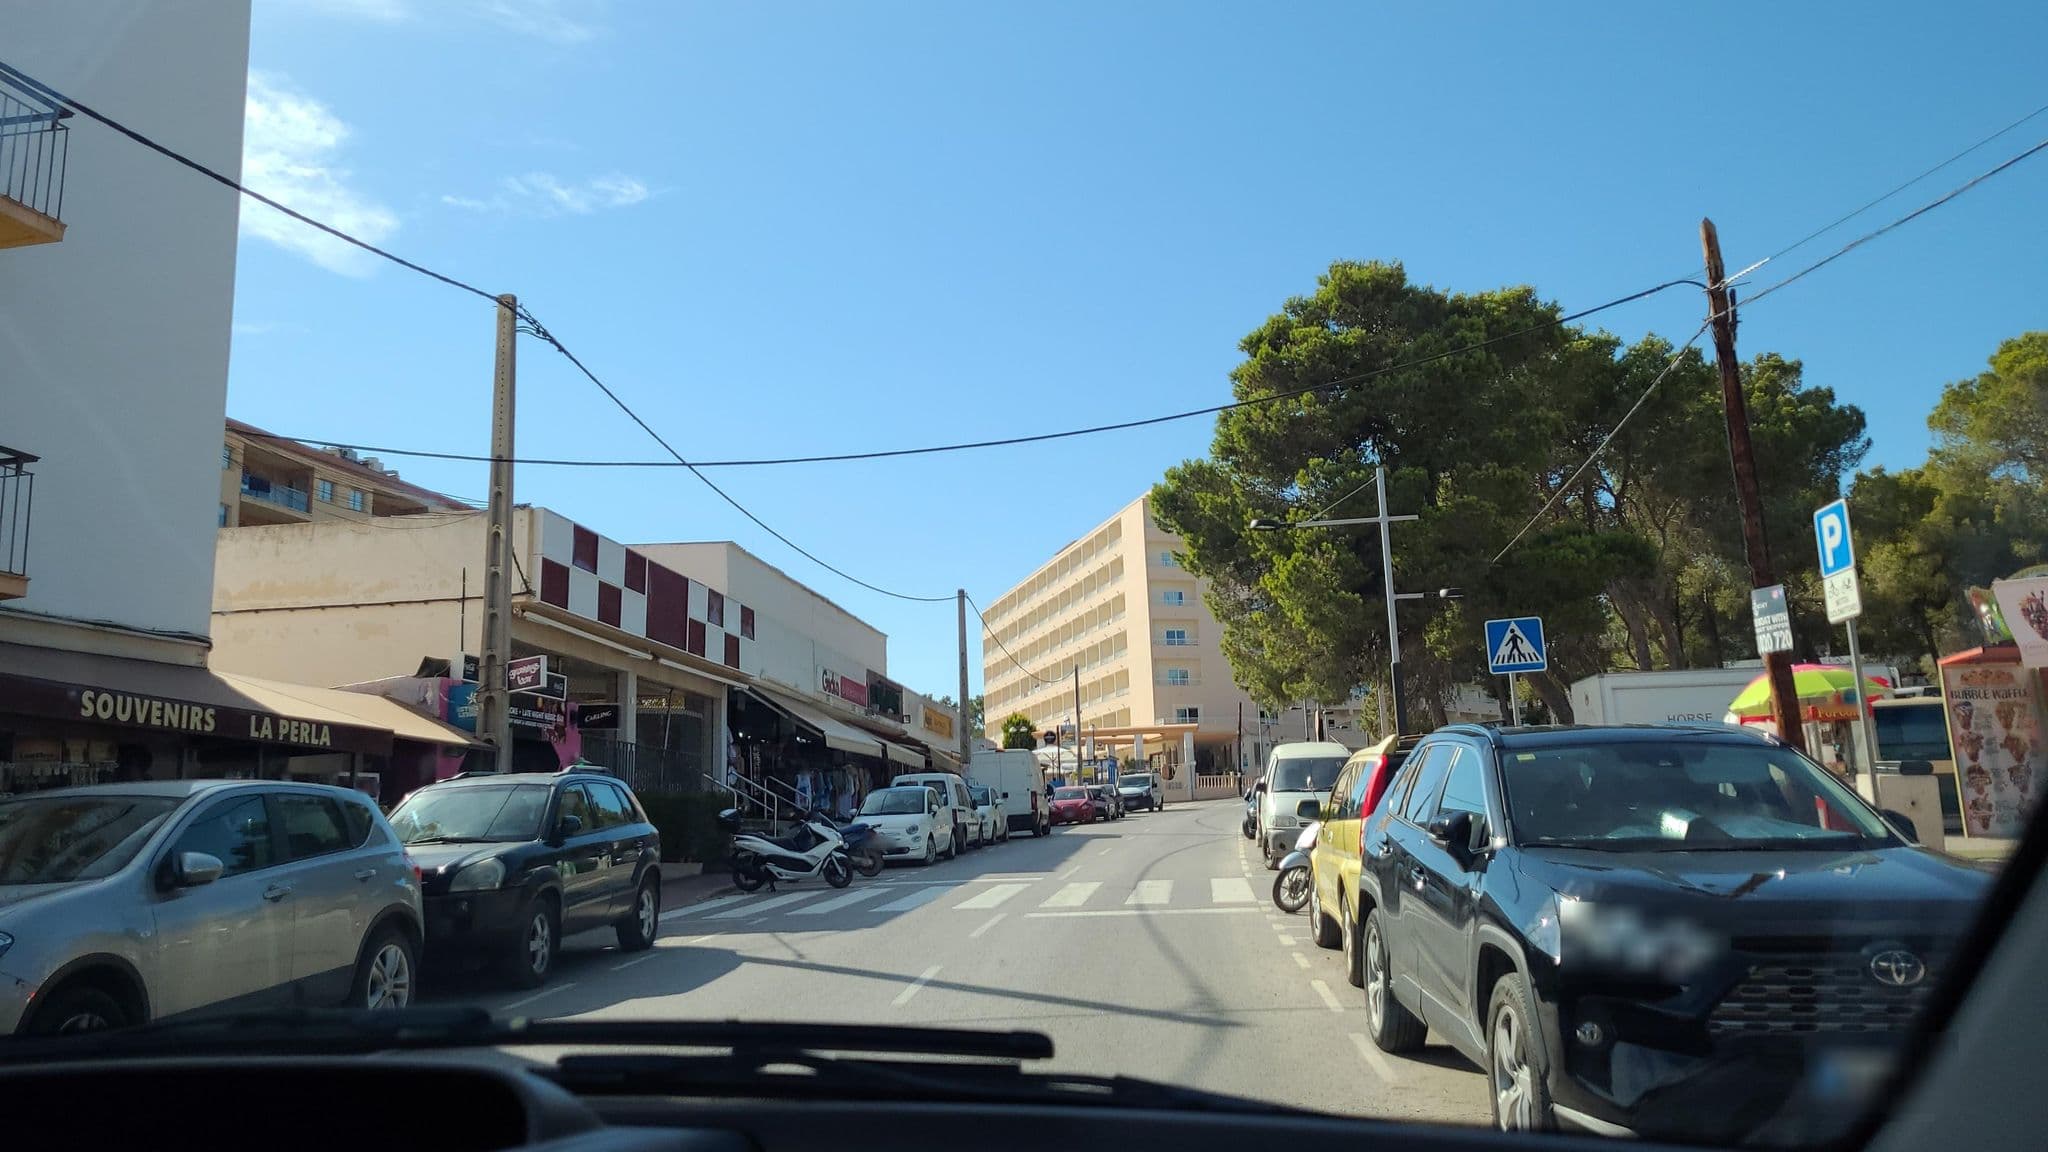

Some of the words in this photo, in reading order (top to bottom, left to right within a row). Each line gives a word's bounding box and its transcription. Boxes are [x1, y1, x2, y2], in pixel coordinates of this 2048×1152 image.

[1821, 513, 1842, 569] P
[81, 690, 216, 732] SOUVENIRS
[1667, 712, 1713, 722] HORSE
[250, 714, 273, 739] LA
[279, 719, 331, 746] PERLA
